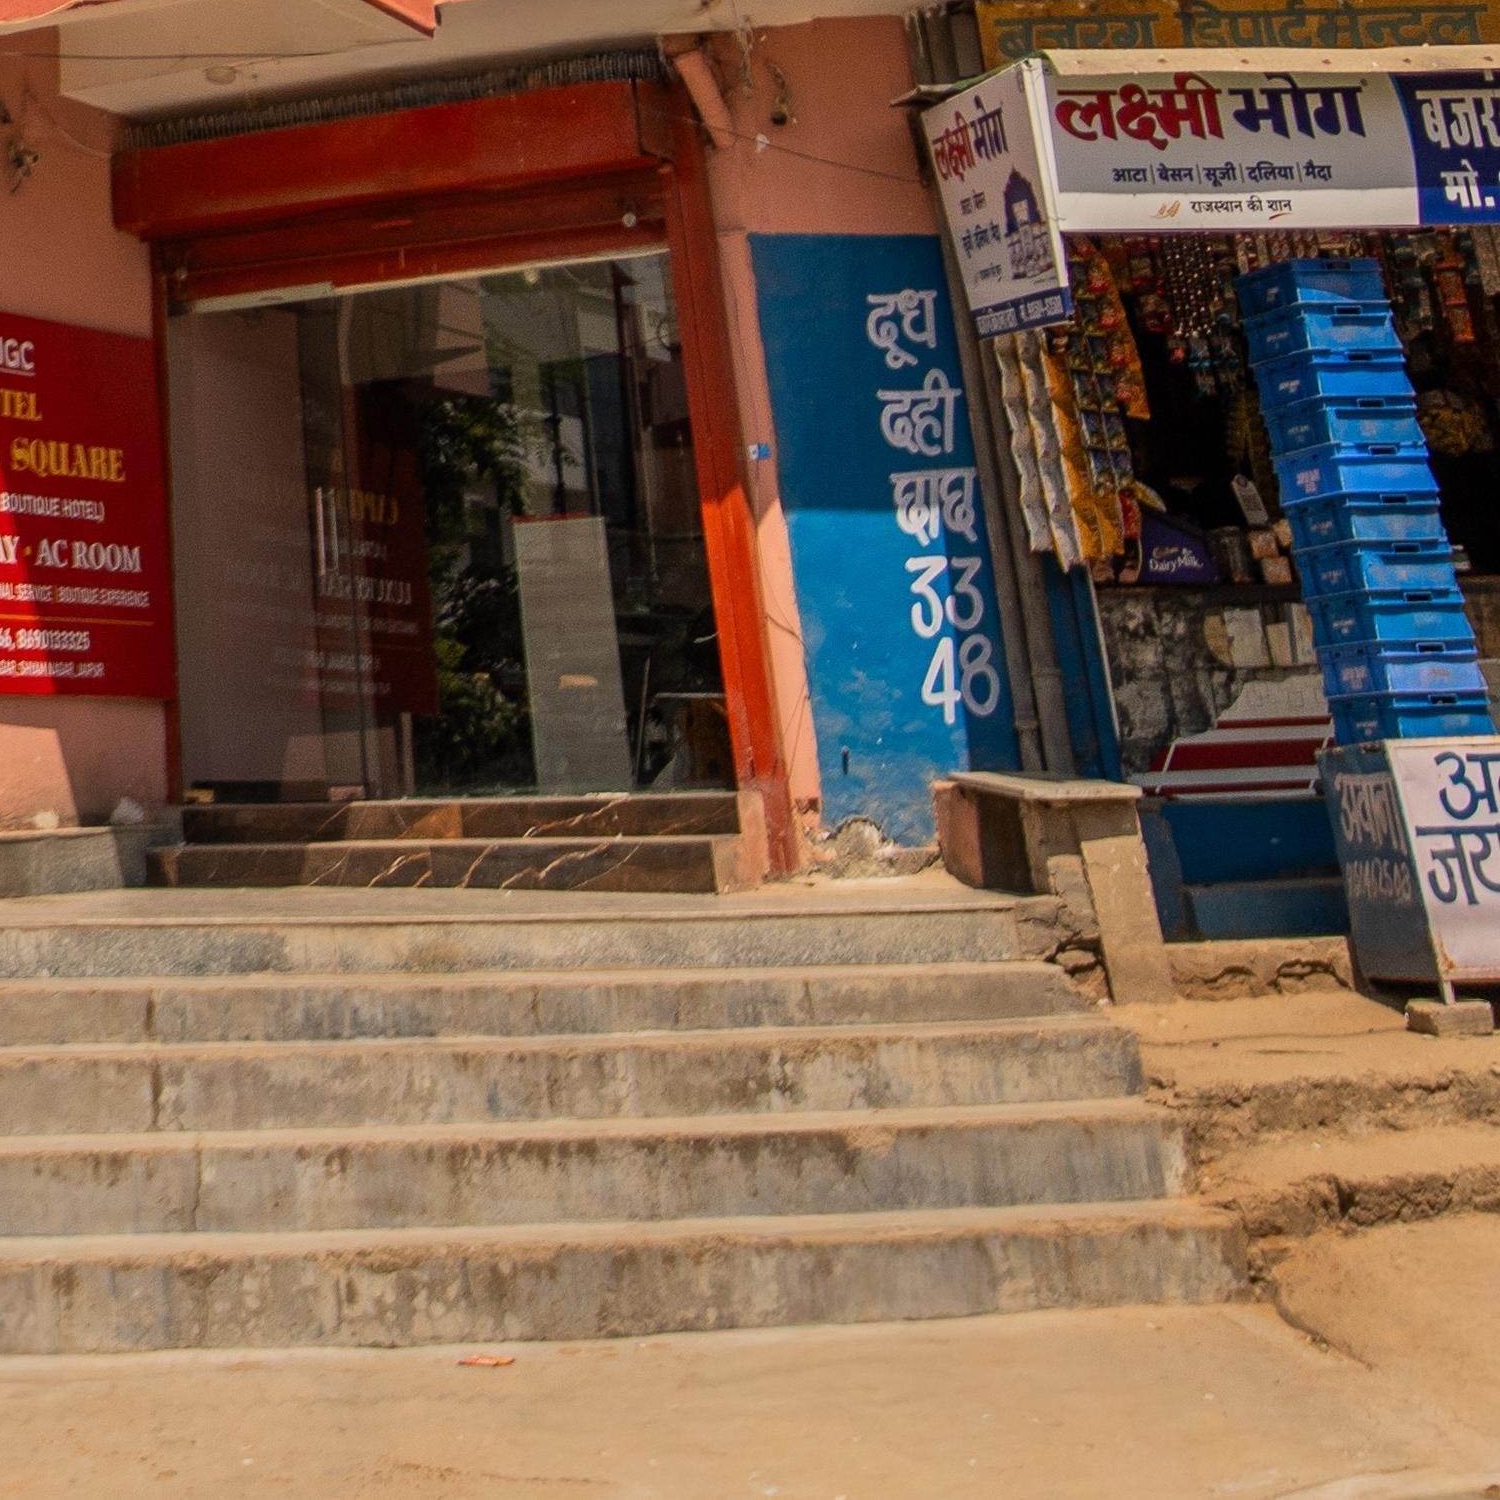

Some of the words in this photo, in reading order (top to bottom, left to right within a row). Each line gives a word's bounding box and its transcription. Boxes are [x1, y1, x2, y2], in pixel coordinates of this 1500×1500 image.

[1055, 72, 1225, 150] लक्ष्मी
[1228, 72, 1367, 139] भोग
[1111, 165, 1148, 183] आटा
[1157, 162, 1194, 183] बेसन
[1202, 160, 1238, 187] सूजी
[1245, 160, 1296, 183] दलिया
[1302, 158, 1333, 182] मैदा
[1190, 198, 1244, 215] राजस्थान
[1247, 195, 1265, 212] की
[1267, 196, 1293, 214] शान
[866, 288, 938, 369] दूध
[876, 368, 963, 456] दही
[10, 436, 127, 483] SQUARE
[0, 491, 61, 517] BOUTIQUE
[33, 537, 68, 569] AC
[71, 539, 143, 573] ROOM
[1148, 558, 1177, 574] Dairy
